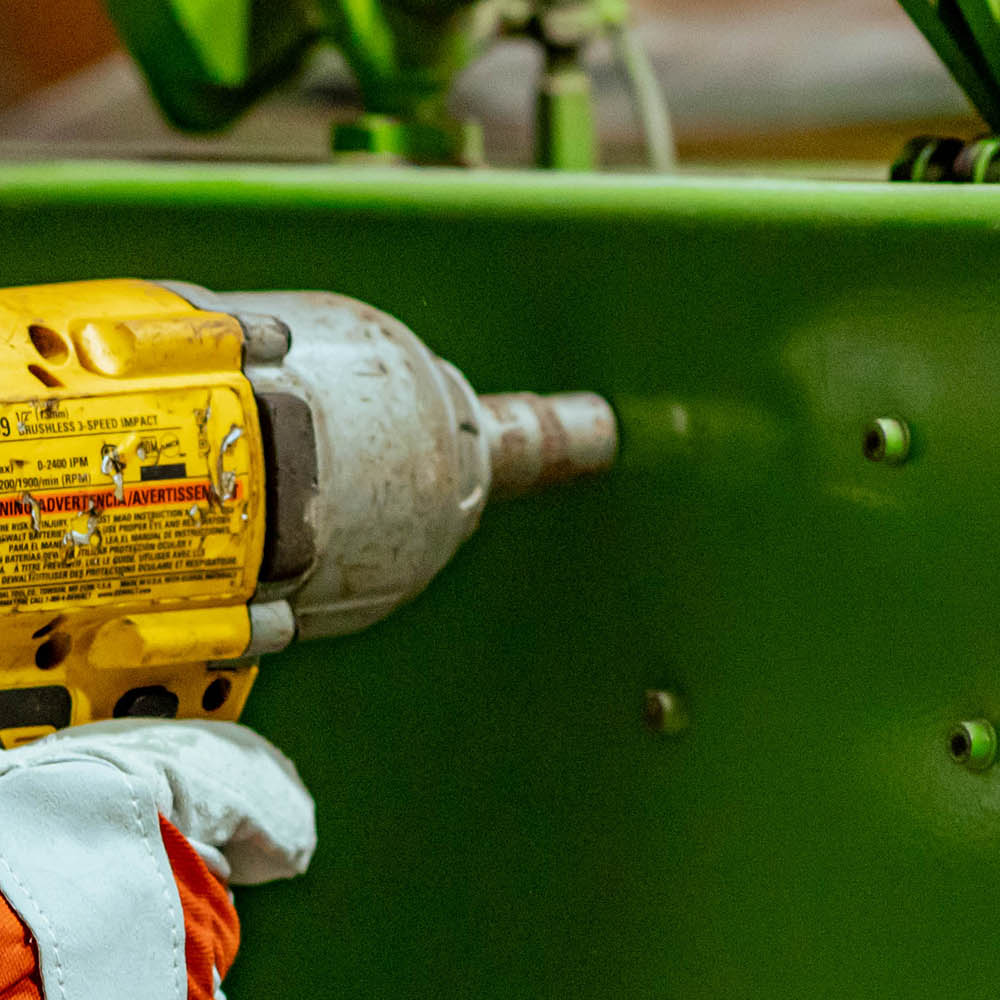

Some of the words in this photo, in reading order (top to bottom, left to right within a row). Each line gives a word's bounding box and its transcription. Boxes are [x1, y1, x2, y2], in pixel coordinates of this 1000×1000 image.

[19, 420, 76, 435] RUSHLESS
[121, 415, 158, 428] IMPACT
[37, 459, 67, 471] 0-2400
[69, 457, 89, 468] IPM
[62, 473, 92, 488] (RPM)
[9, 543, 28, 552] PARA
